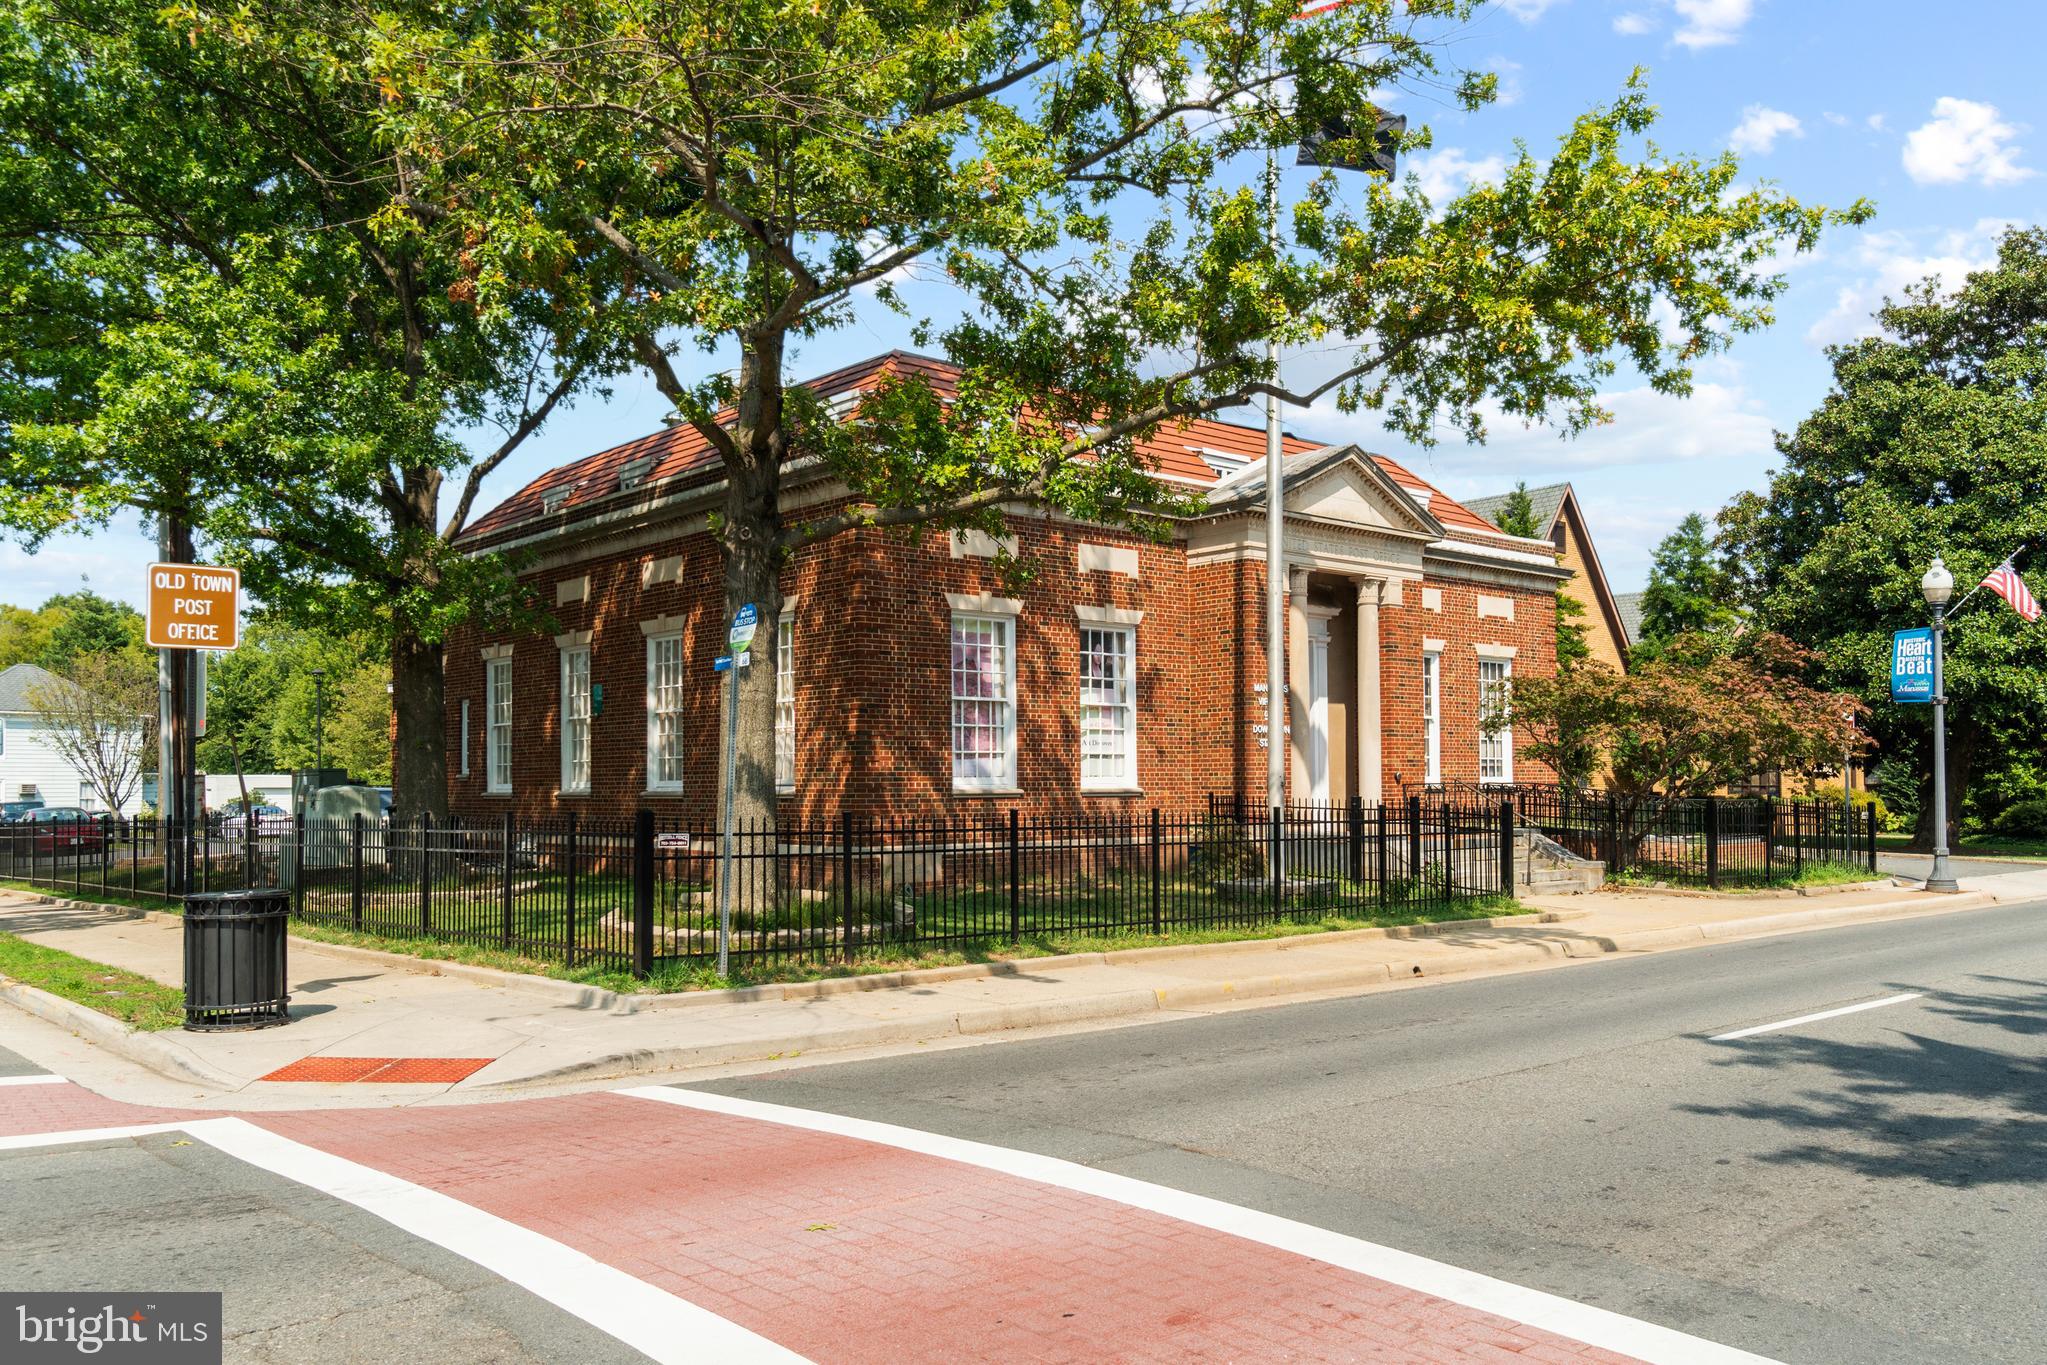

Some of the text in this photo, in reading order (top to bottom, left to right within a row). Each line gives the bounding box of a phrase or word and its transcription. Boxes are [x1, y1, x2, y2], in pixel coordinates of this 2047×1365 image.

[1374, 550, 1401, 564] OFFICE
[155, 572, 232, 593] OLD TOWN
[174, 598, 213, 616] POST
[735, 616, 756, 627] BUS STOP
[167, 622, 219, 641] OFFICE
[1897, 638, 1932, 657] Heart
[1896, 656, 1933, 675] Beat
